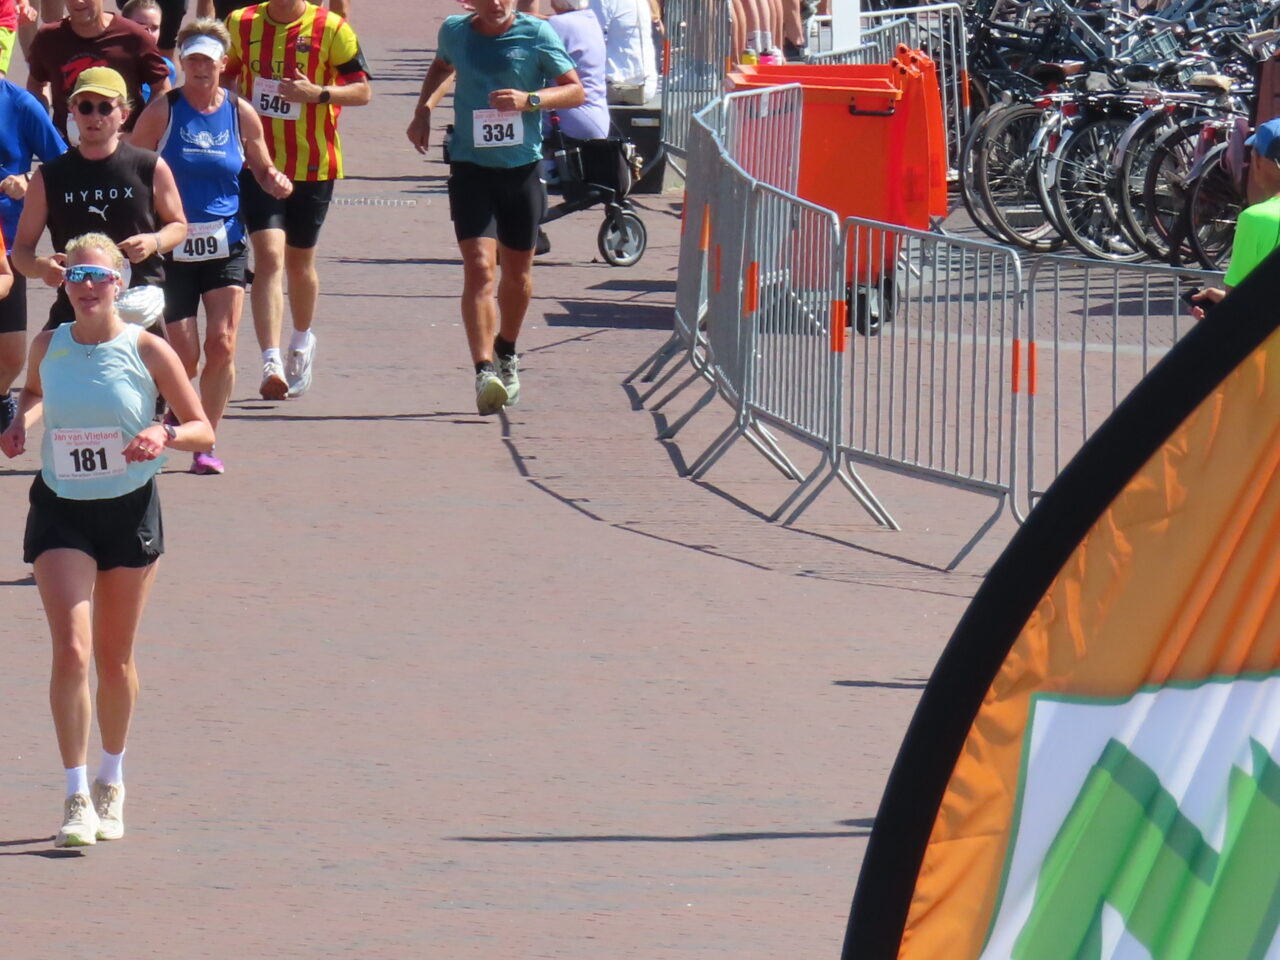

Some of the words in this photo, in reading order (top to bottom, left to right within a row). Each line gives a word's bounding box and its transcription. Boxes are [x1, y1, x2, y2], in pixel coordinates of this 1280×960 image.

[260, 93, 291, 115] 546
[482, 123, 515, 142] 334
[64, 186, 134, 203] HYROX
[183, 235, 218, 257] 409
[69, 447, 108, 472] 181
